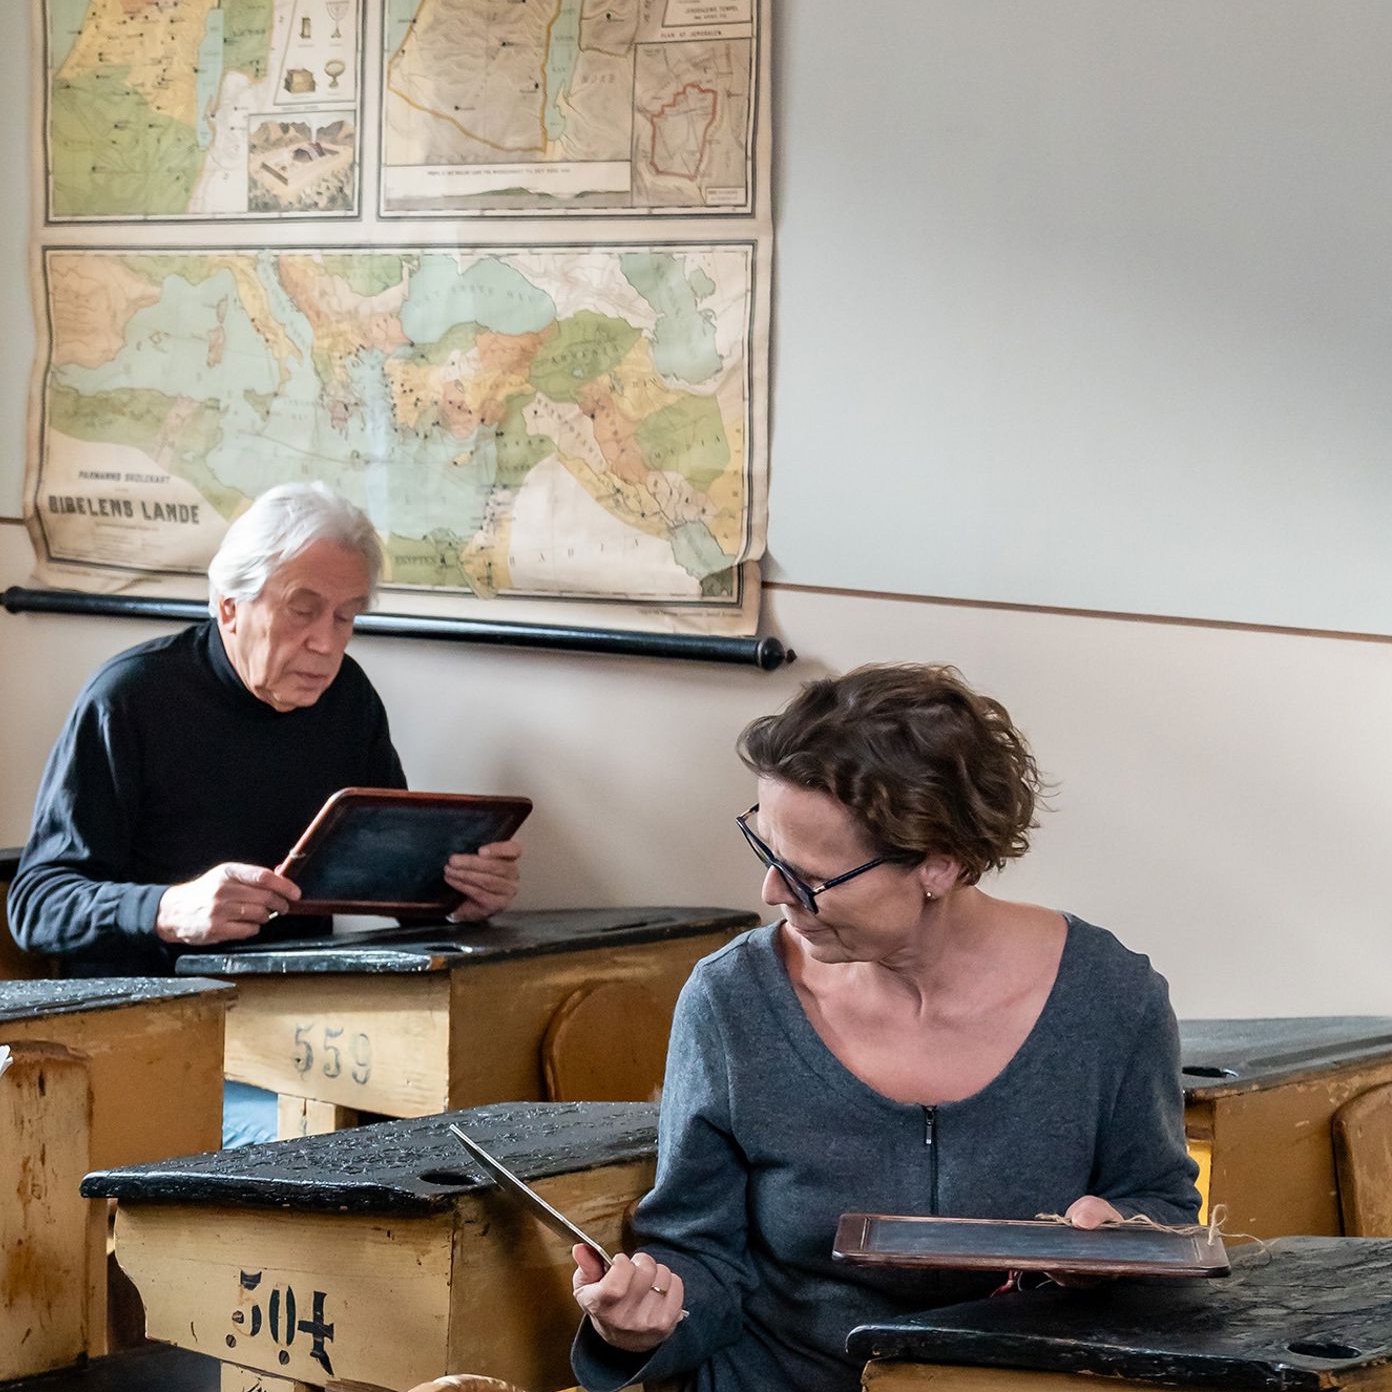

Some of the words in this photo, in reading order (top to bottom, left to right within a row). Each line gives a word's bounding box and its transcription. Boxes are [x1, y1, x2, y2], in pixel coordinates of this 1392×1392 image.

[48, 495, 134, 518] BIBELENS
[141, 501, 200, 524] LANDE
[293, 1022, 373, 1086] 559
[231, 1269, 335, 1378] 504
